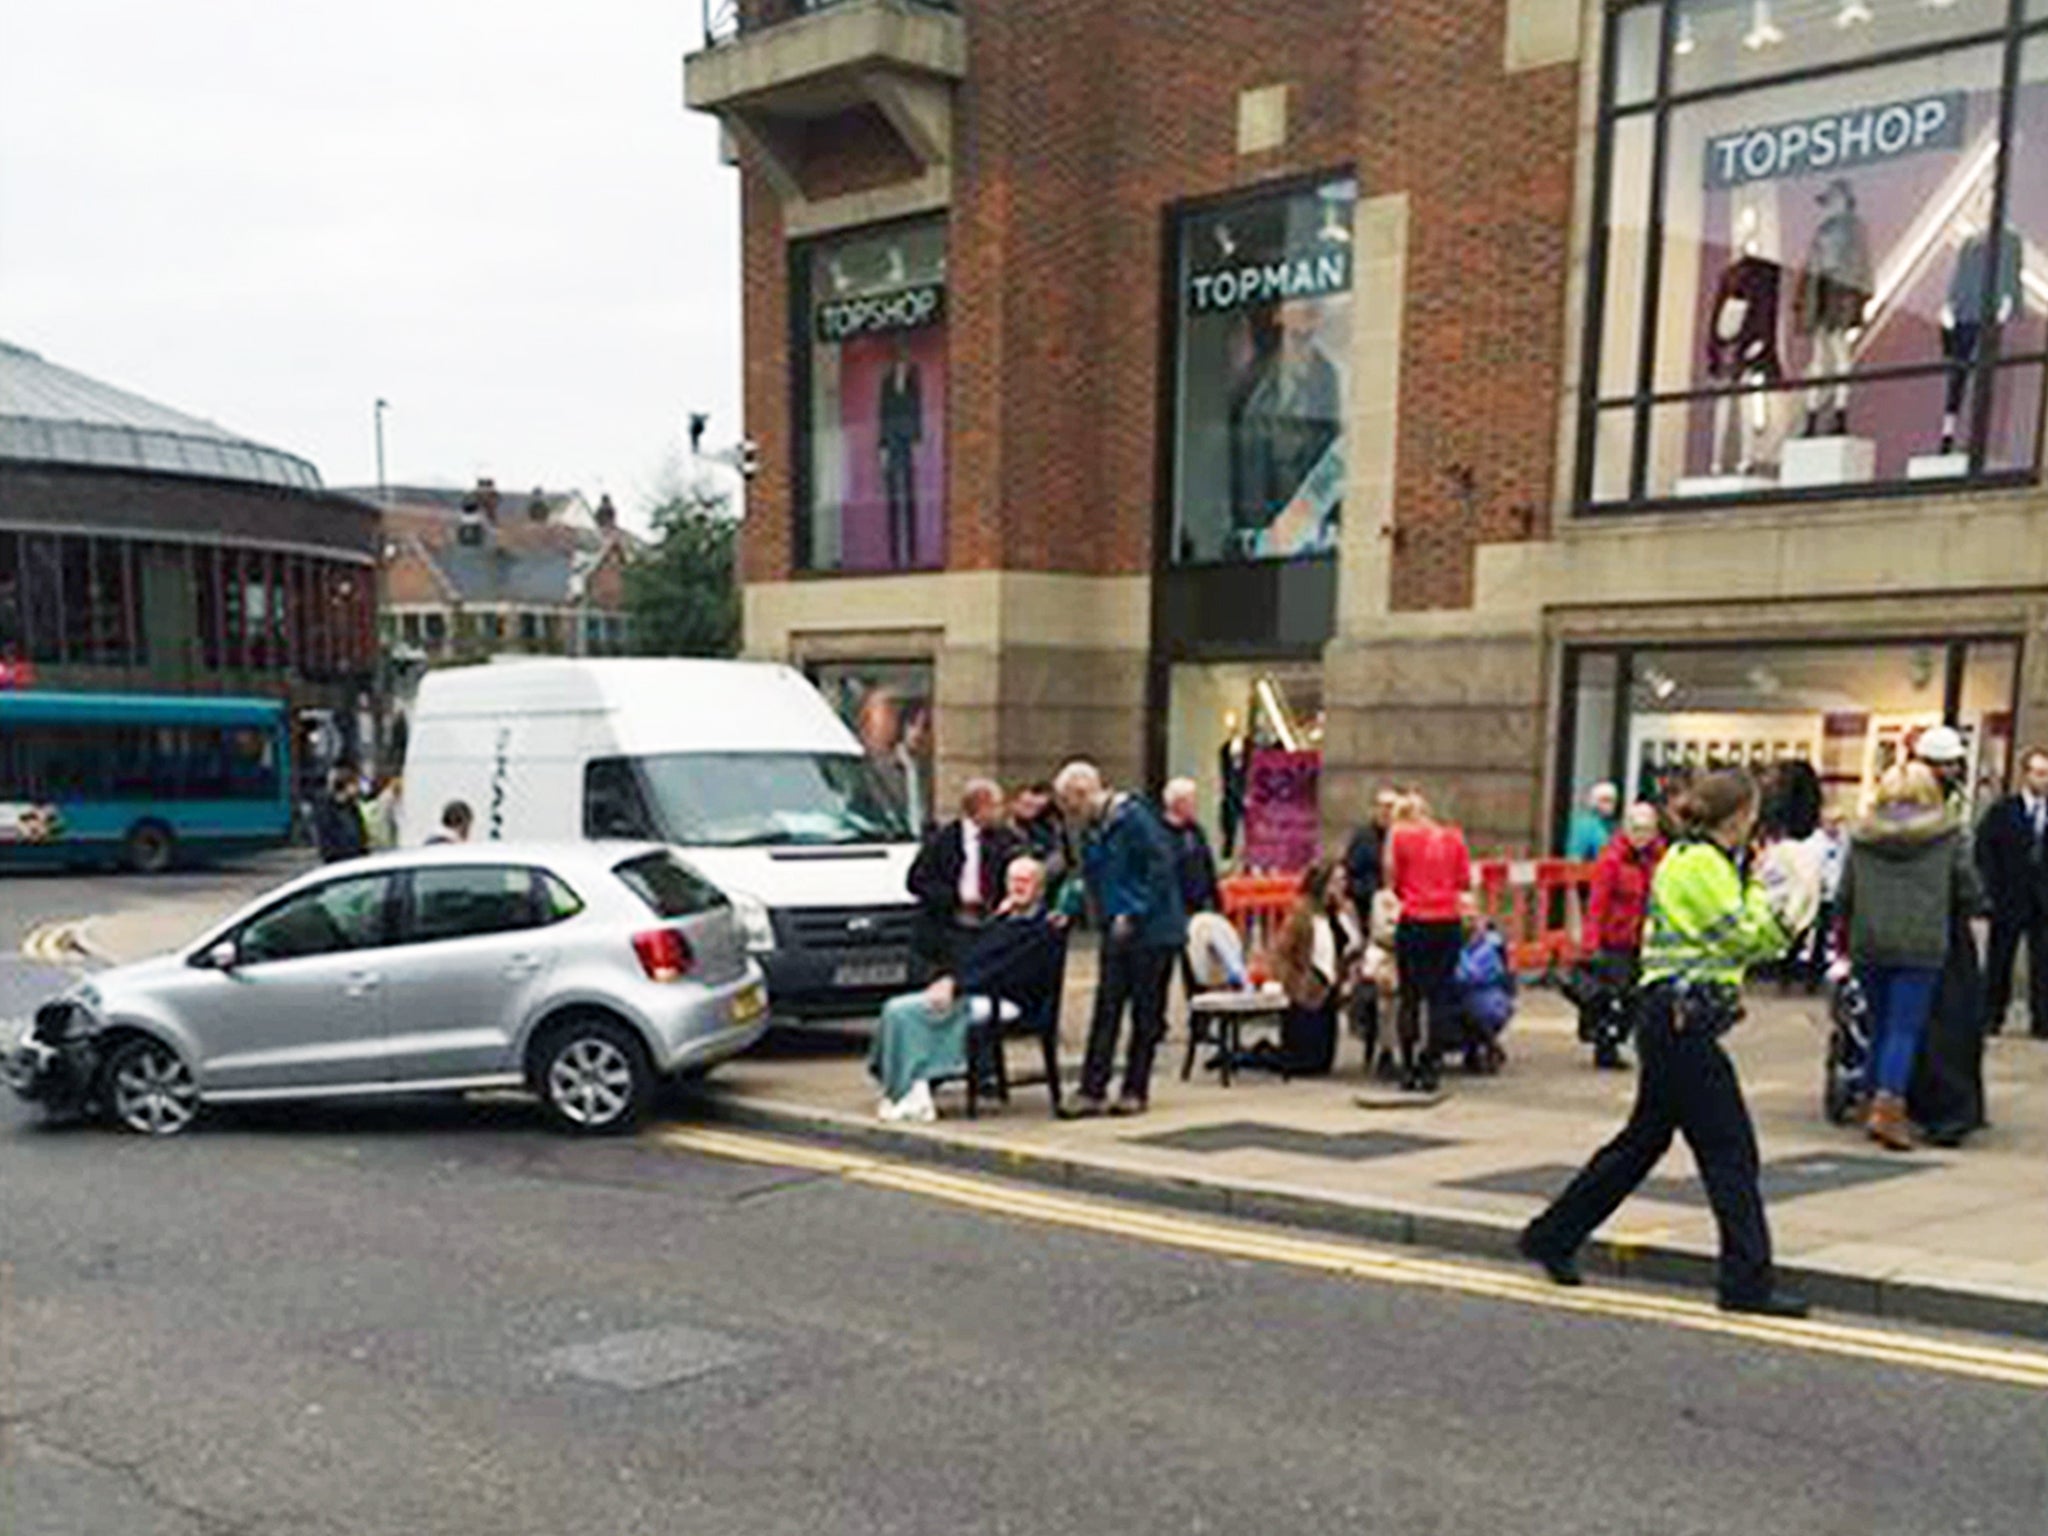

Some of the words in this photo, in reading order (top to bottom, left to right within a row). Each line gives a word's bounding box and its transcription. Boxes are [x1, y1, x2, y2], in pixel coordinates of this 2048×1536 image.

[1715, 100, 1946, 179] TOPSHOP
[1193, 254, 1345, 308] TOPMAN
[823, 289, 937, 336] TOPSHOP
